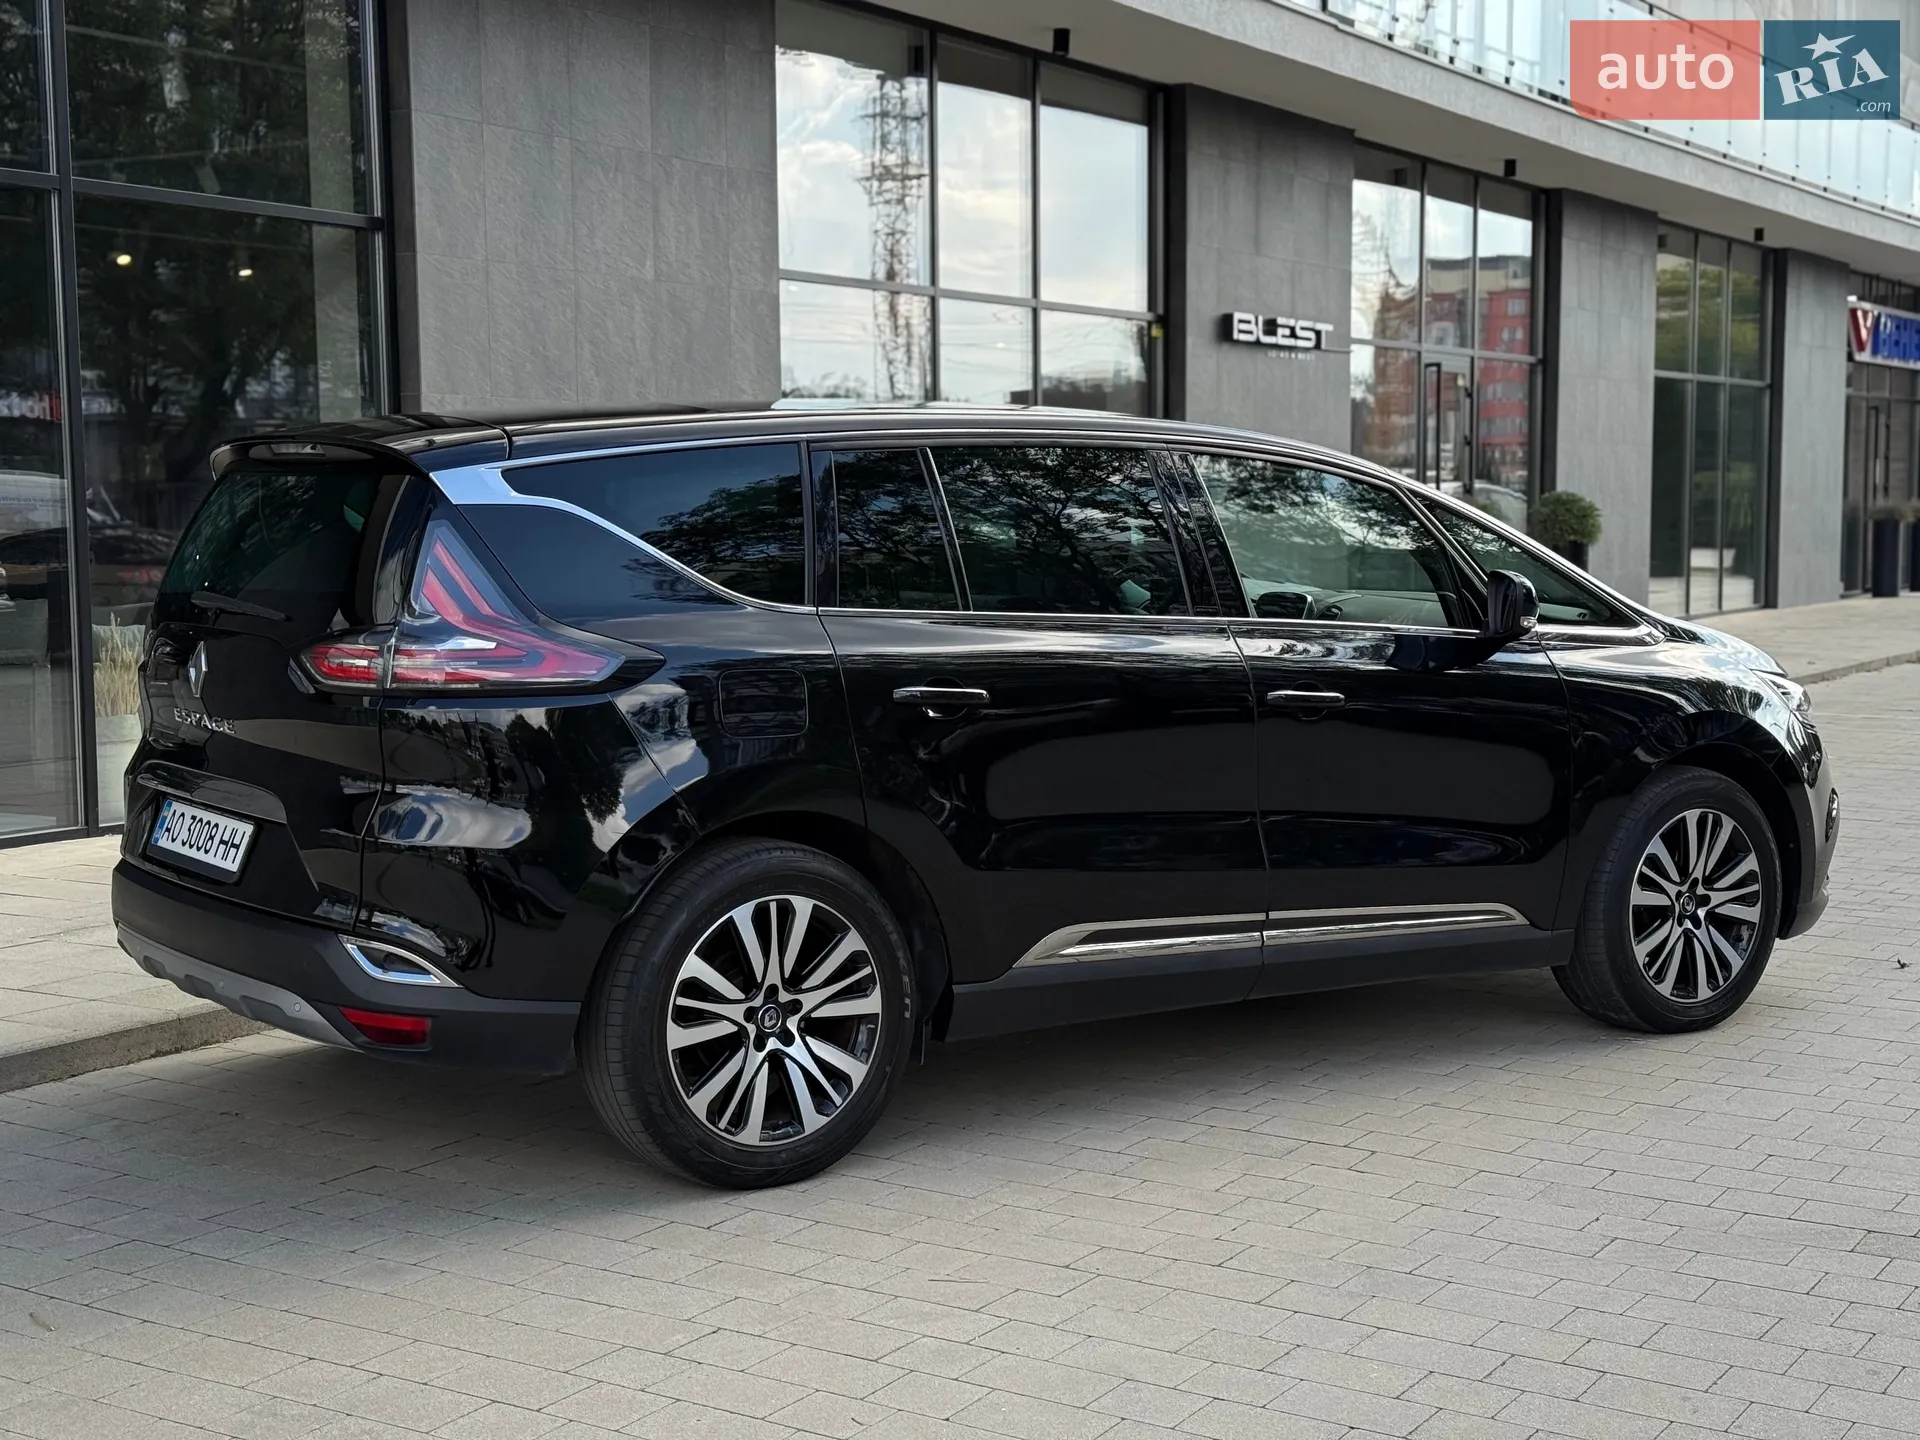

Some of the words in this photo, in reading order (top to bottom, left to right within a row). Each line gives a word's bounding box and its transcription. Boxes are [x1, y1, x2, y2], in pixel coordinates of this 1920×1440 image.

[1232, 311, 1334, 349] BLEST
[173, 706, 236, 735] ESPACE
[161, 809, 185, 843] AO
[181, 814, 220, 856] 3008
[213, 824, 247, 865] HH
